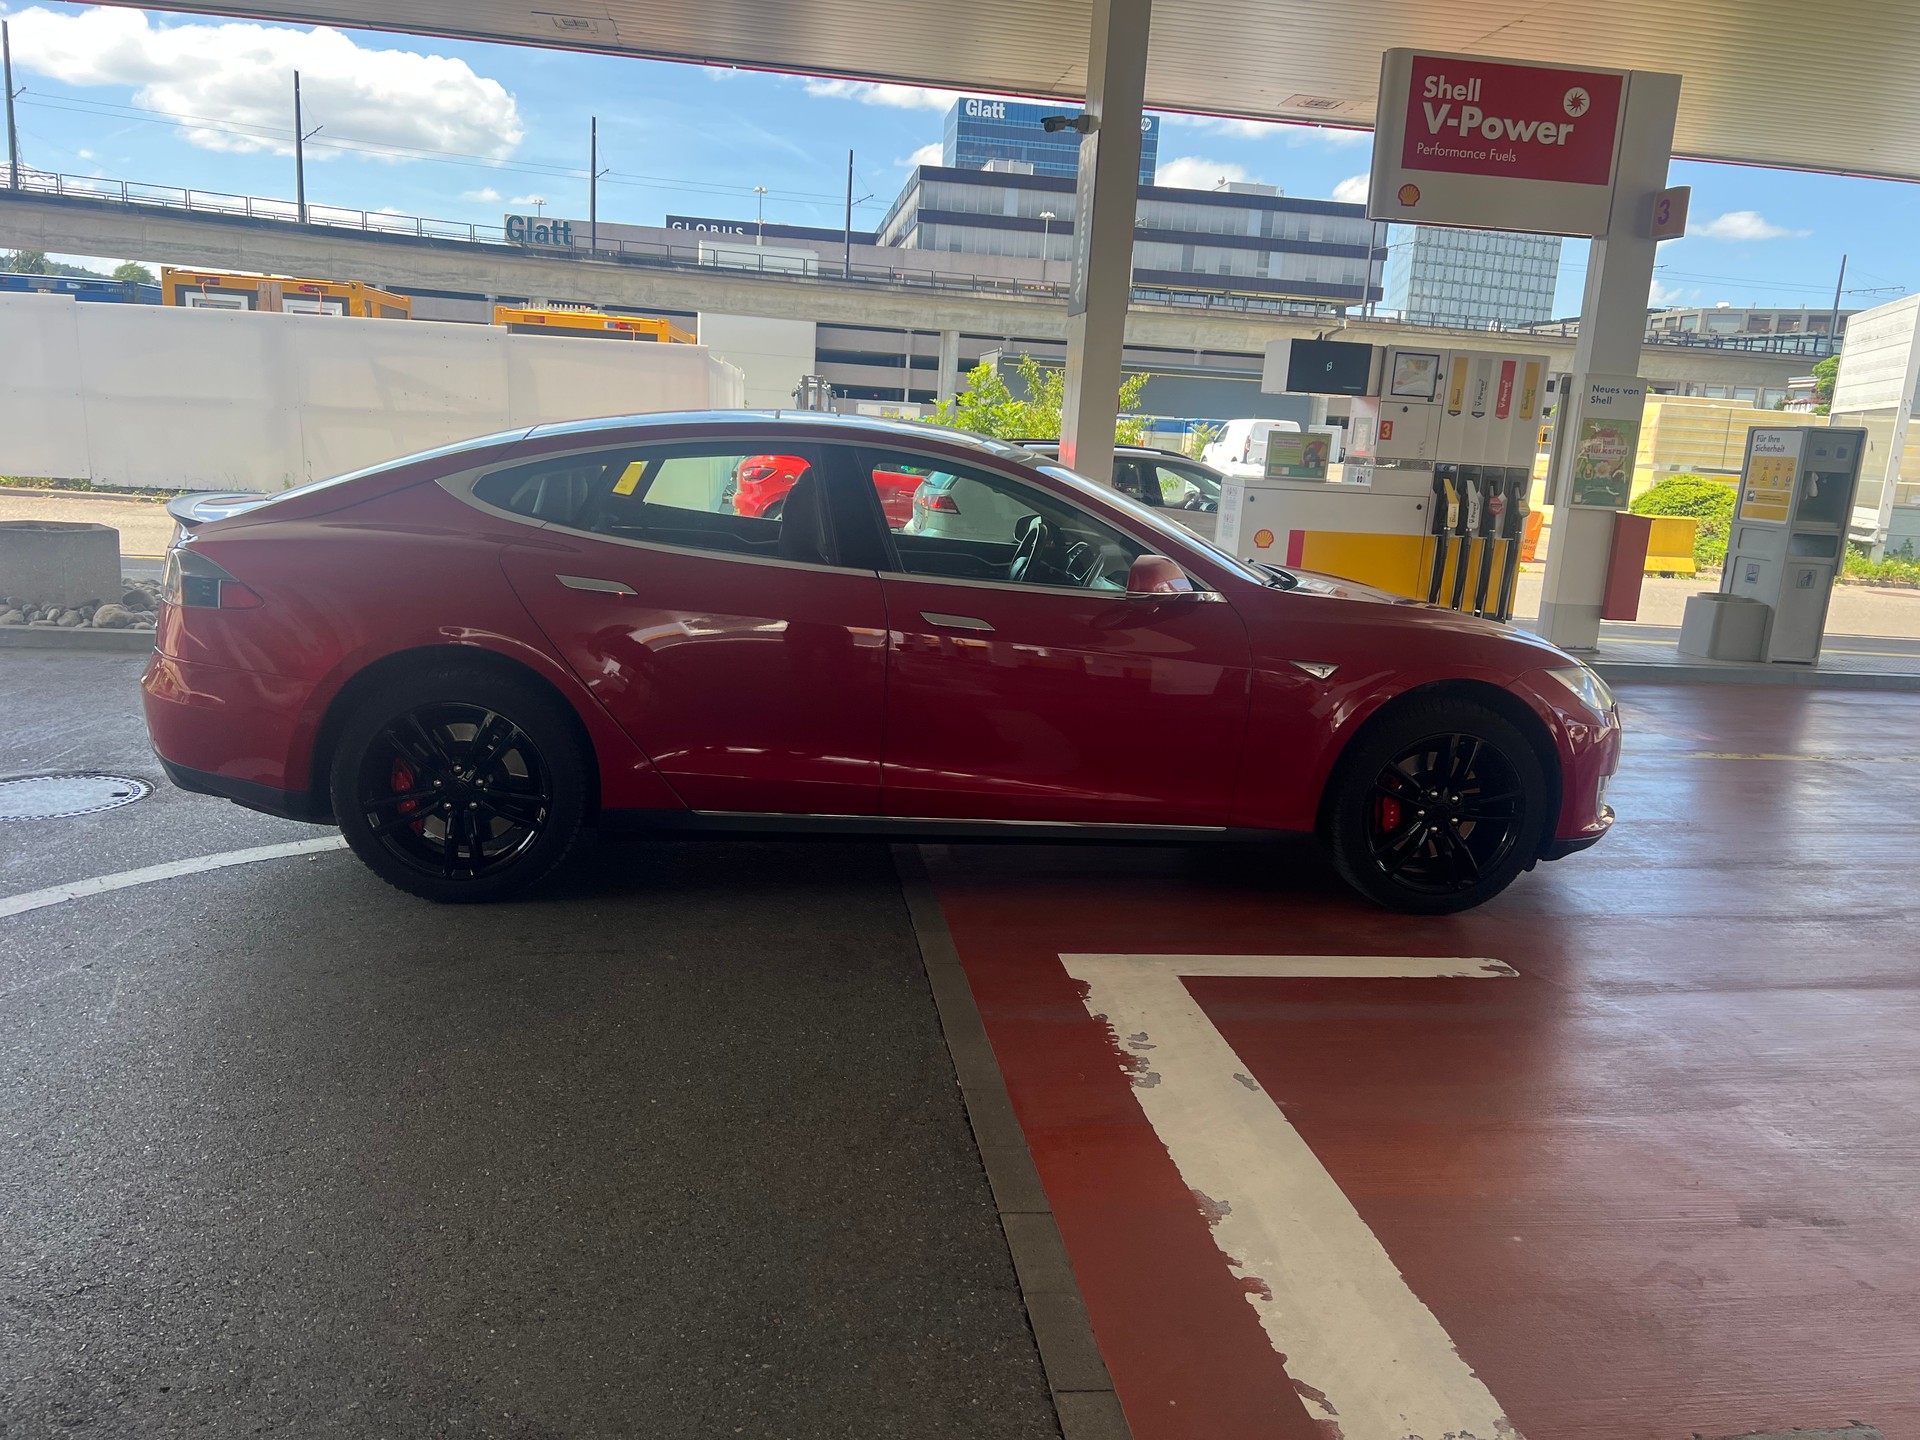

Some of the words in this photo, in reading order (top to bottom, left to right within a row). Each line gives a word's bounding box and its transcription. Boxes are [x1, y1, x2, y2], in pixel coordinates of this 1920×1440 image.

[1423, 75, 1482, 102] Shell
[965, 99, 1006, 119] Glatt
[1422, 102, 1575, 145] V-Power
[1416, 142, 1487, 160] Performance
[1489, 148, 1517, 163] Fuels
[1657, 199, 1671, 225] 3
[506, 215, 572, 246] Glatt
[671, 221, 745, 235] GLOBUS
[1074, 183, 1089, 304] Automat
[1500, 381, 1509, 408] V-Power
[1592, 384, 1620, 394] Neues
[1590, 395, 1612, 405] Shell
[1381, 422, 1391, 438] 3
[1756, 434, 1767, 443] Für
[1767, 434, 1781, 443] Ihre
[1754, 444, 1785, 453] Sicherheit
